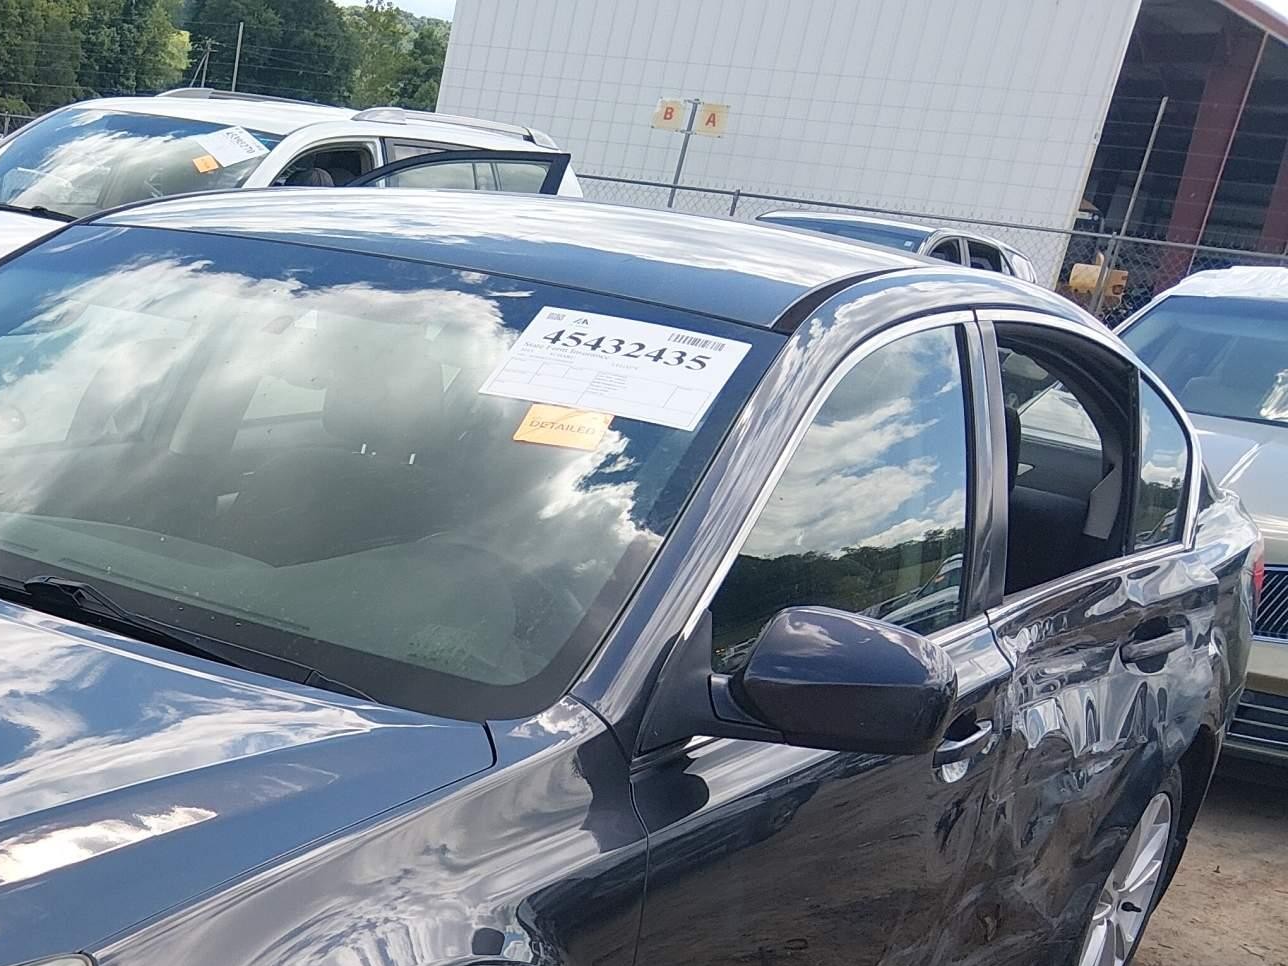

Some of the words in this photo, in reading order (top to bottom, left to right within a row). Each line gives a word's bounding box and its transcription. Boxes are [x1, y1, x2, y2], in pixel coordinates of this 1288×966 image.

[663, 106, 675, 121] B
[705, 112, 717, 128] A
[542, 329, 711, 371] 45432435
[528, 420, 597, 435] DETAILED
